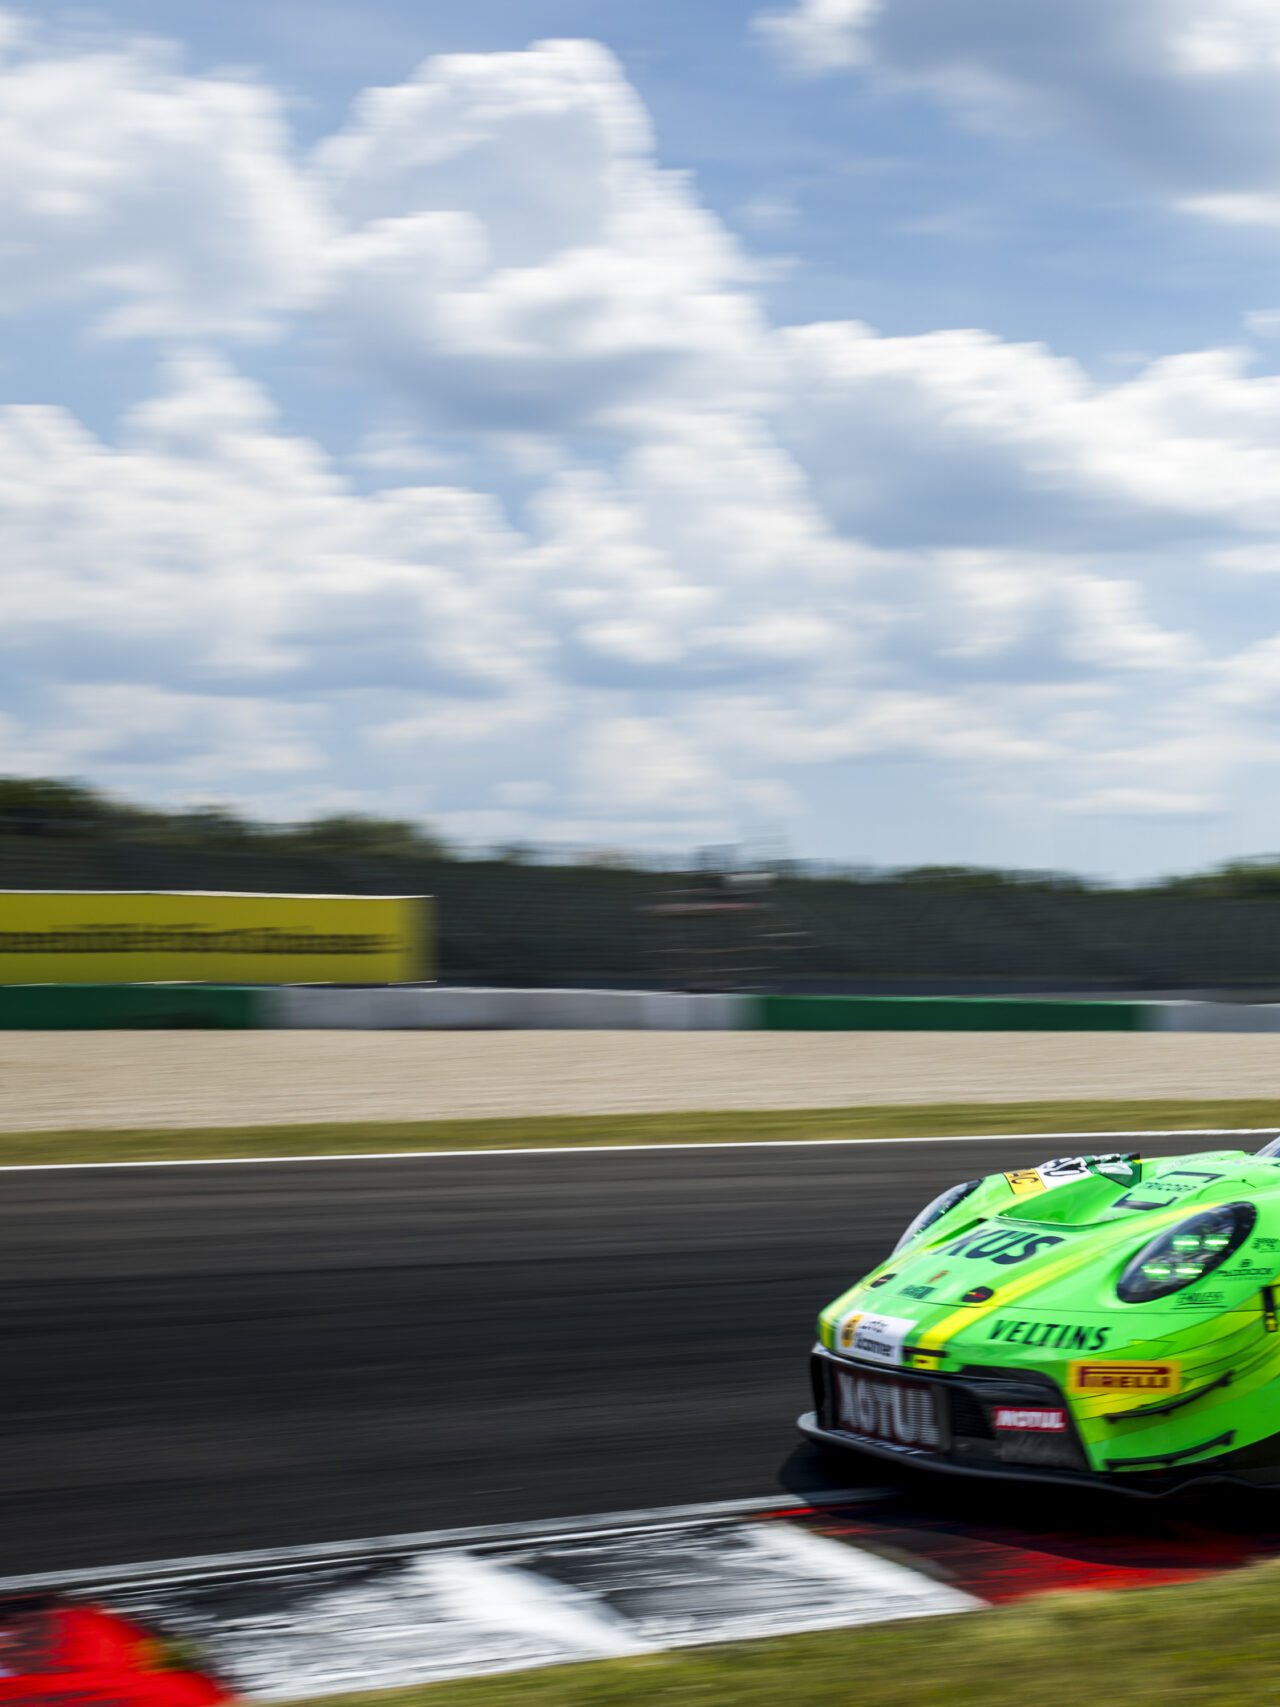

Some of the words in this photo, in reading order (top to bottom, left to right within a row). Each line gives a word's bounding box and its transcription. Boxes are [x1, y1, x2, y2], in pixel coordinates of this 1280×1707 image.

[987, 1319, 1113, 1351] VELTINS
[1078, 1365, 1172, 1389] PIRELLI
[837, 1371, 940, 1445] MOTUL
[995, 1410, 1066, 1429] MOTUL
